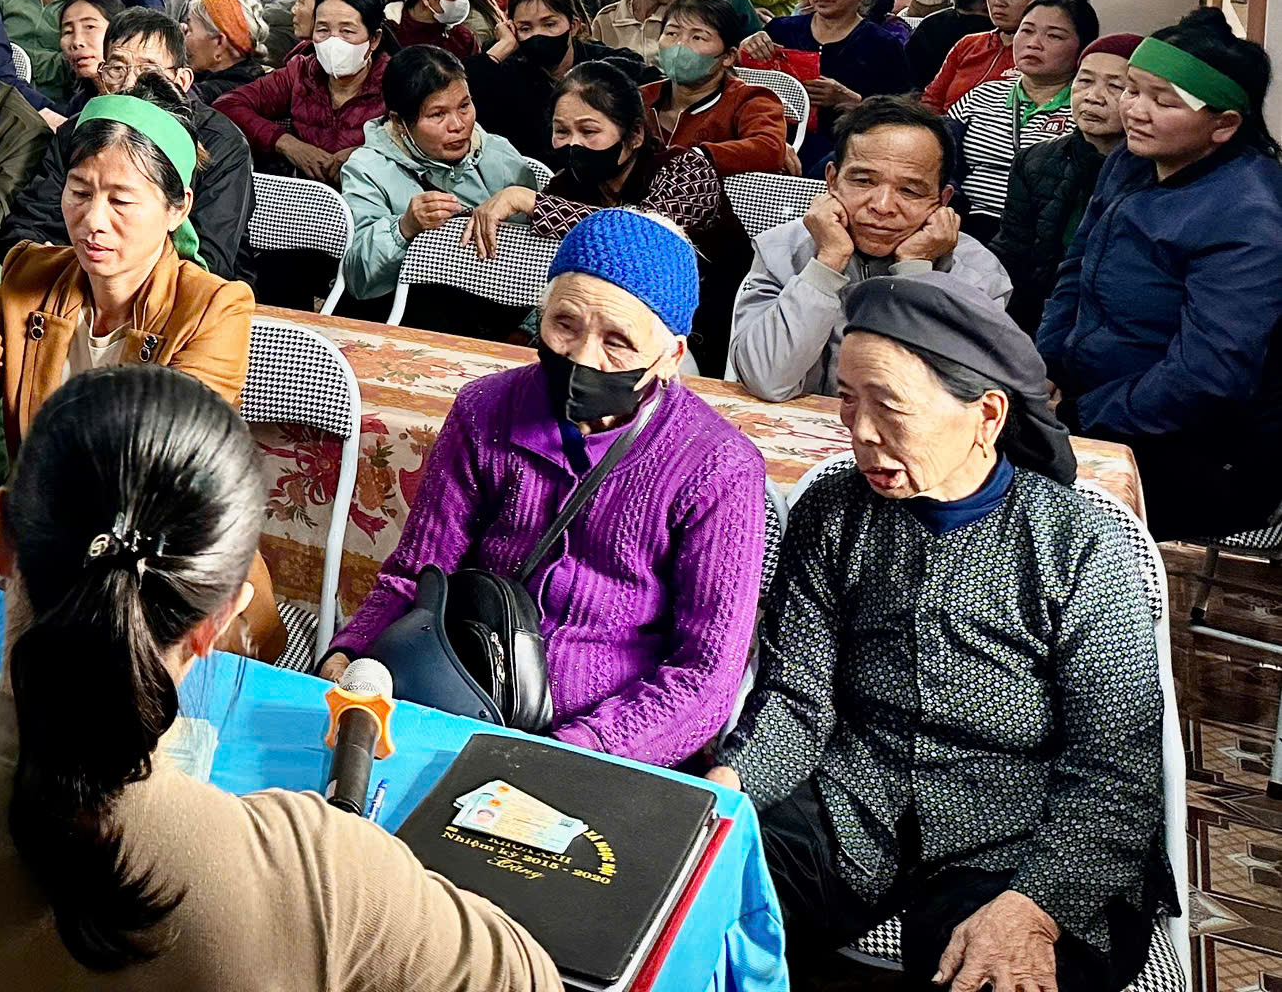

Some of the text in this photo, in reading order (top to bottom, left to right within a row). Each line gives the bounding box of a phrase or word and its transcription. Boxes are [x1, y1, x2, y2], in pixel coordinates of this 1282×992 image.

[441, 831, 495, 852] Nhiệm
[522, 854, 560, 870] 2015
[571, 869, 611, 884] 2020
